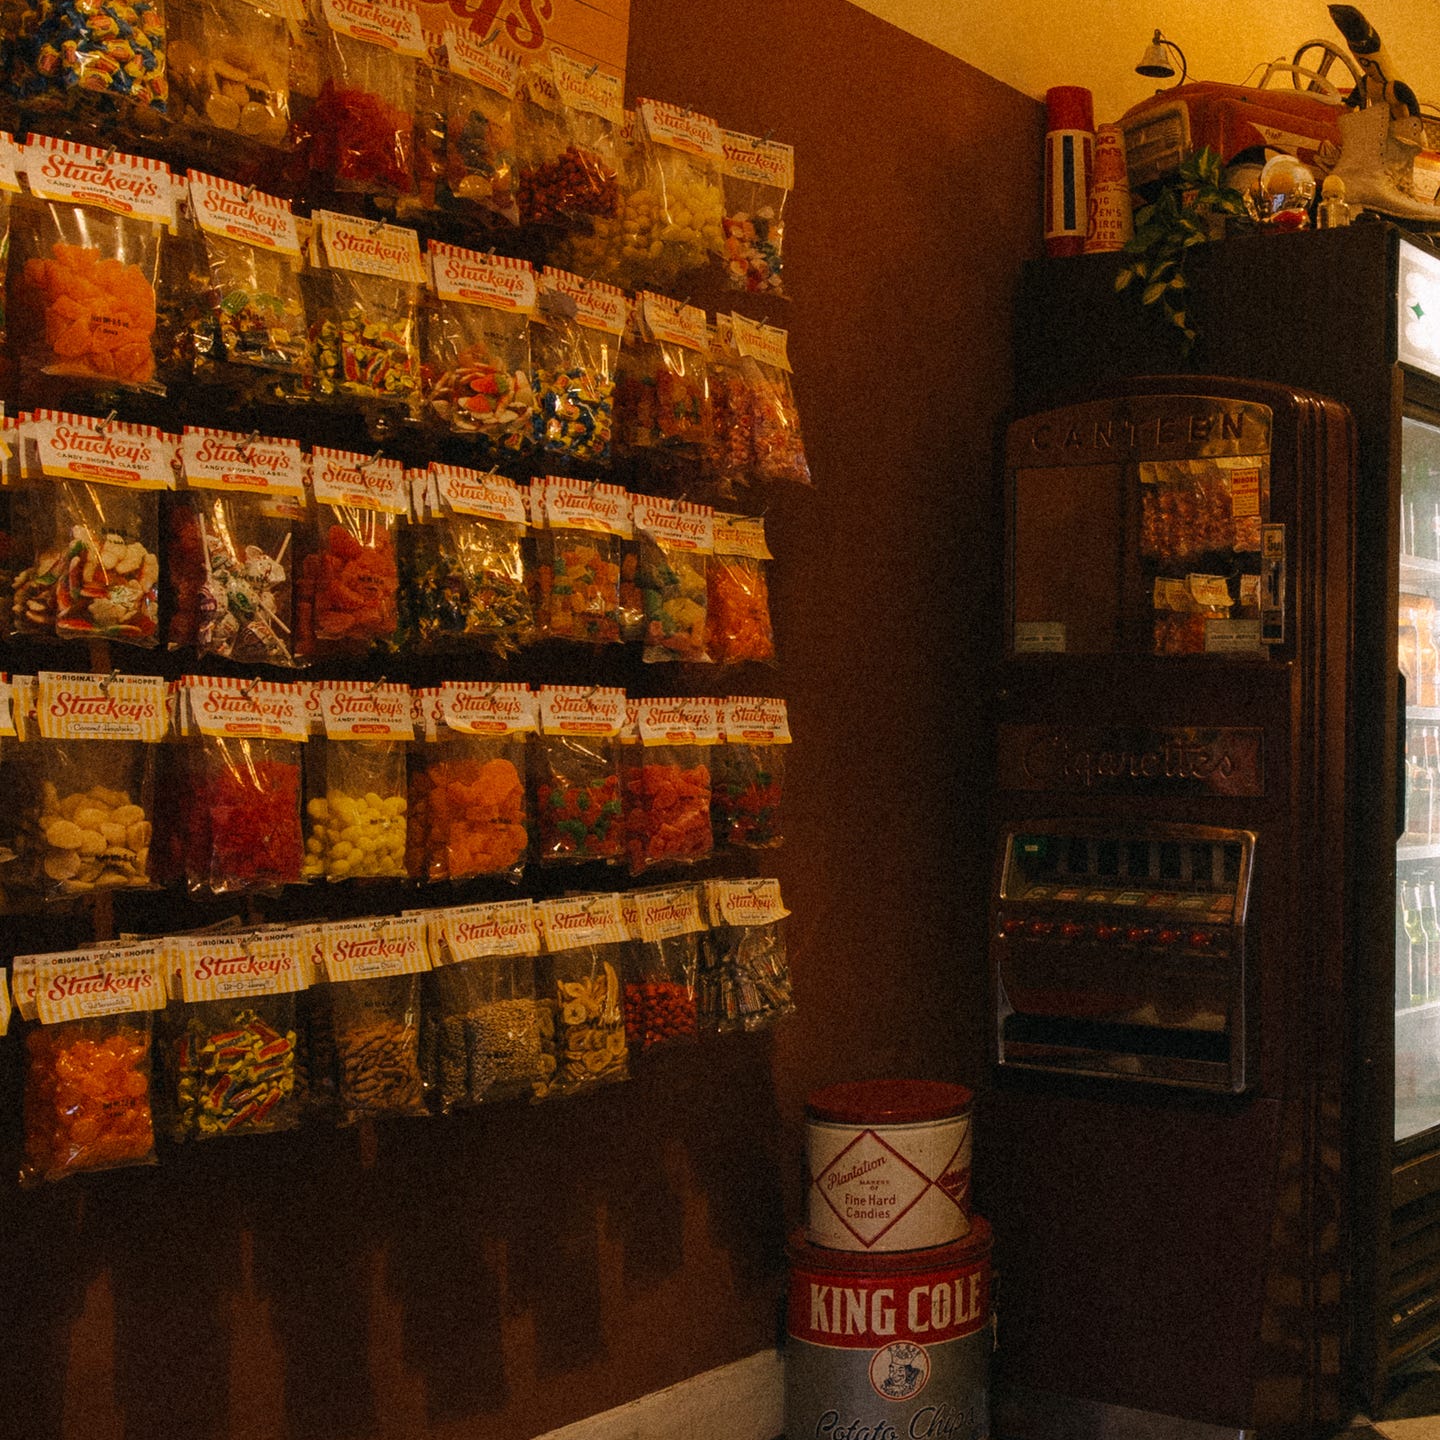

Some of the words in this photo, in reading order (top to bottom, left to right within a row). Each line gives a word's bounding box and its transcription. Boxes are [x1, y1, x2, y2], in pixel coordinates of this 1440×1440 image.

[42, 154, 159, 198] Stuckey's
[203, 189, 287, 232] Stuckey's
[333, 229, 410, 263] Stuckey's
[445, 259, 524, 292] Stuckey's
[51, 427, 152, 462] Stuckey's
[1031, 412, 1245, 451] CANTEEN
[196, 438, 291, 470] Stuckey's
[322, 461, 395, 492] Stuckey's
[447, 479, 515, 507] Stuckey's
[554, 490, 618, 517] Stuckey's
[643, 509, 706, 536] Stuckey's
[56, 674, 95, 683] ORIGINAL
[127, 677, 157, 686] SHOPPE
[51, 691, 155, 720] Stuckey's
[203, 690, 294, 719] Stuckey's
[330, 693, 403, 717] Stuckey's
[452, 692, 521, 716] Stuckey's
[550, 694, 618, 717] Stuckey's
[646, 707, 710, 726] Stuckey's
[731, 706, 783, 724] Stuckey's
[1023, 734, 1234, 787] Cigarettes
[645, 903, 692, 925] Stuckey's
[726, 893, 776, 911] Stuckey's
[455, 919, 526, 943] Stuckey's
[551, 910, 614, 932] Stuckey's
[52, 954, 90, 966] ORIGINAL
[125, 948, 155, 958] SHOPPE
[333, 937, 417, 962] Stuckey's
[194, 953, 292, 981] Stuckey's
[48, 969, 153, 1001] Stuckey's
[826, 1155, 887, 1191] Plantation
[844, 1193, 866, 1206] Fine
[868, 1194, 896, 1206] Hard
[845, 1207, 891, 1220] Candies
[809, 1283, 898, 1336] KING
[907, 1272, 982, 1334] COLE
